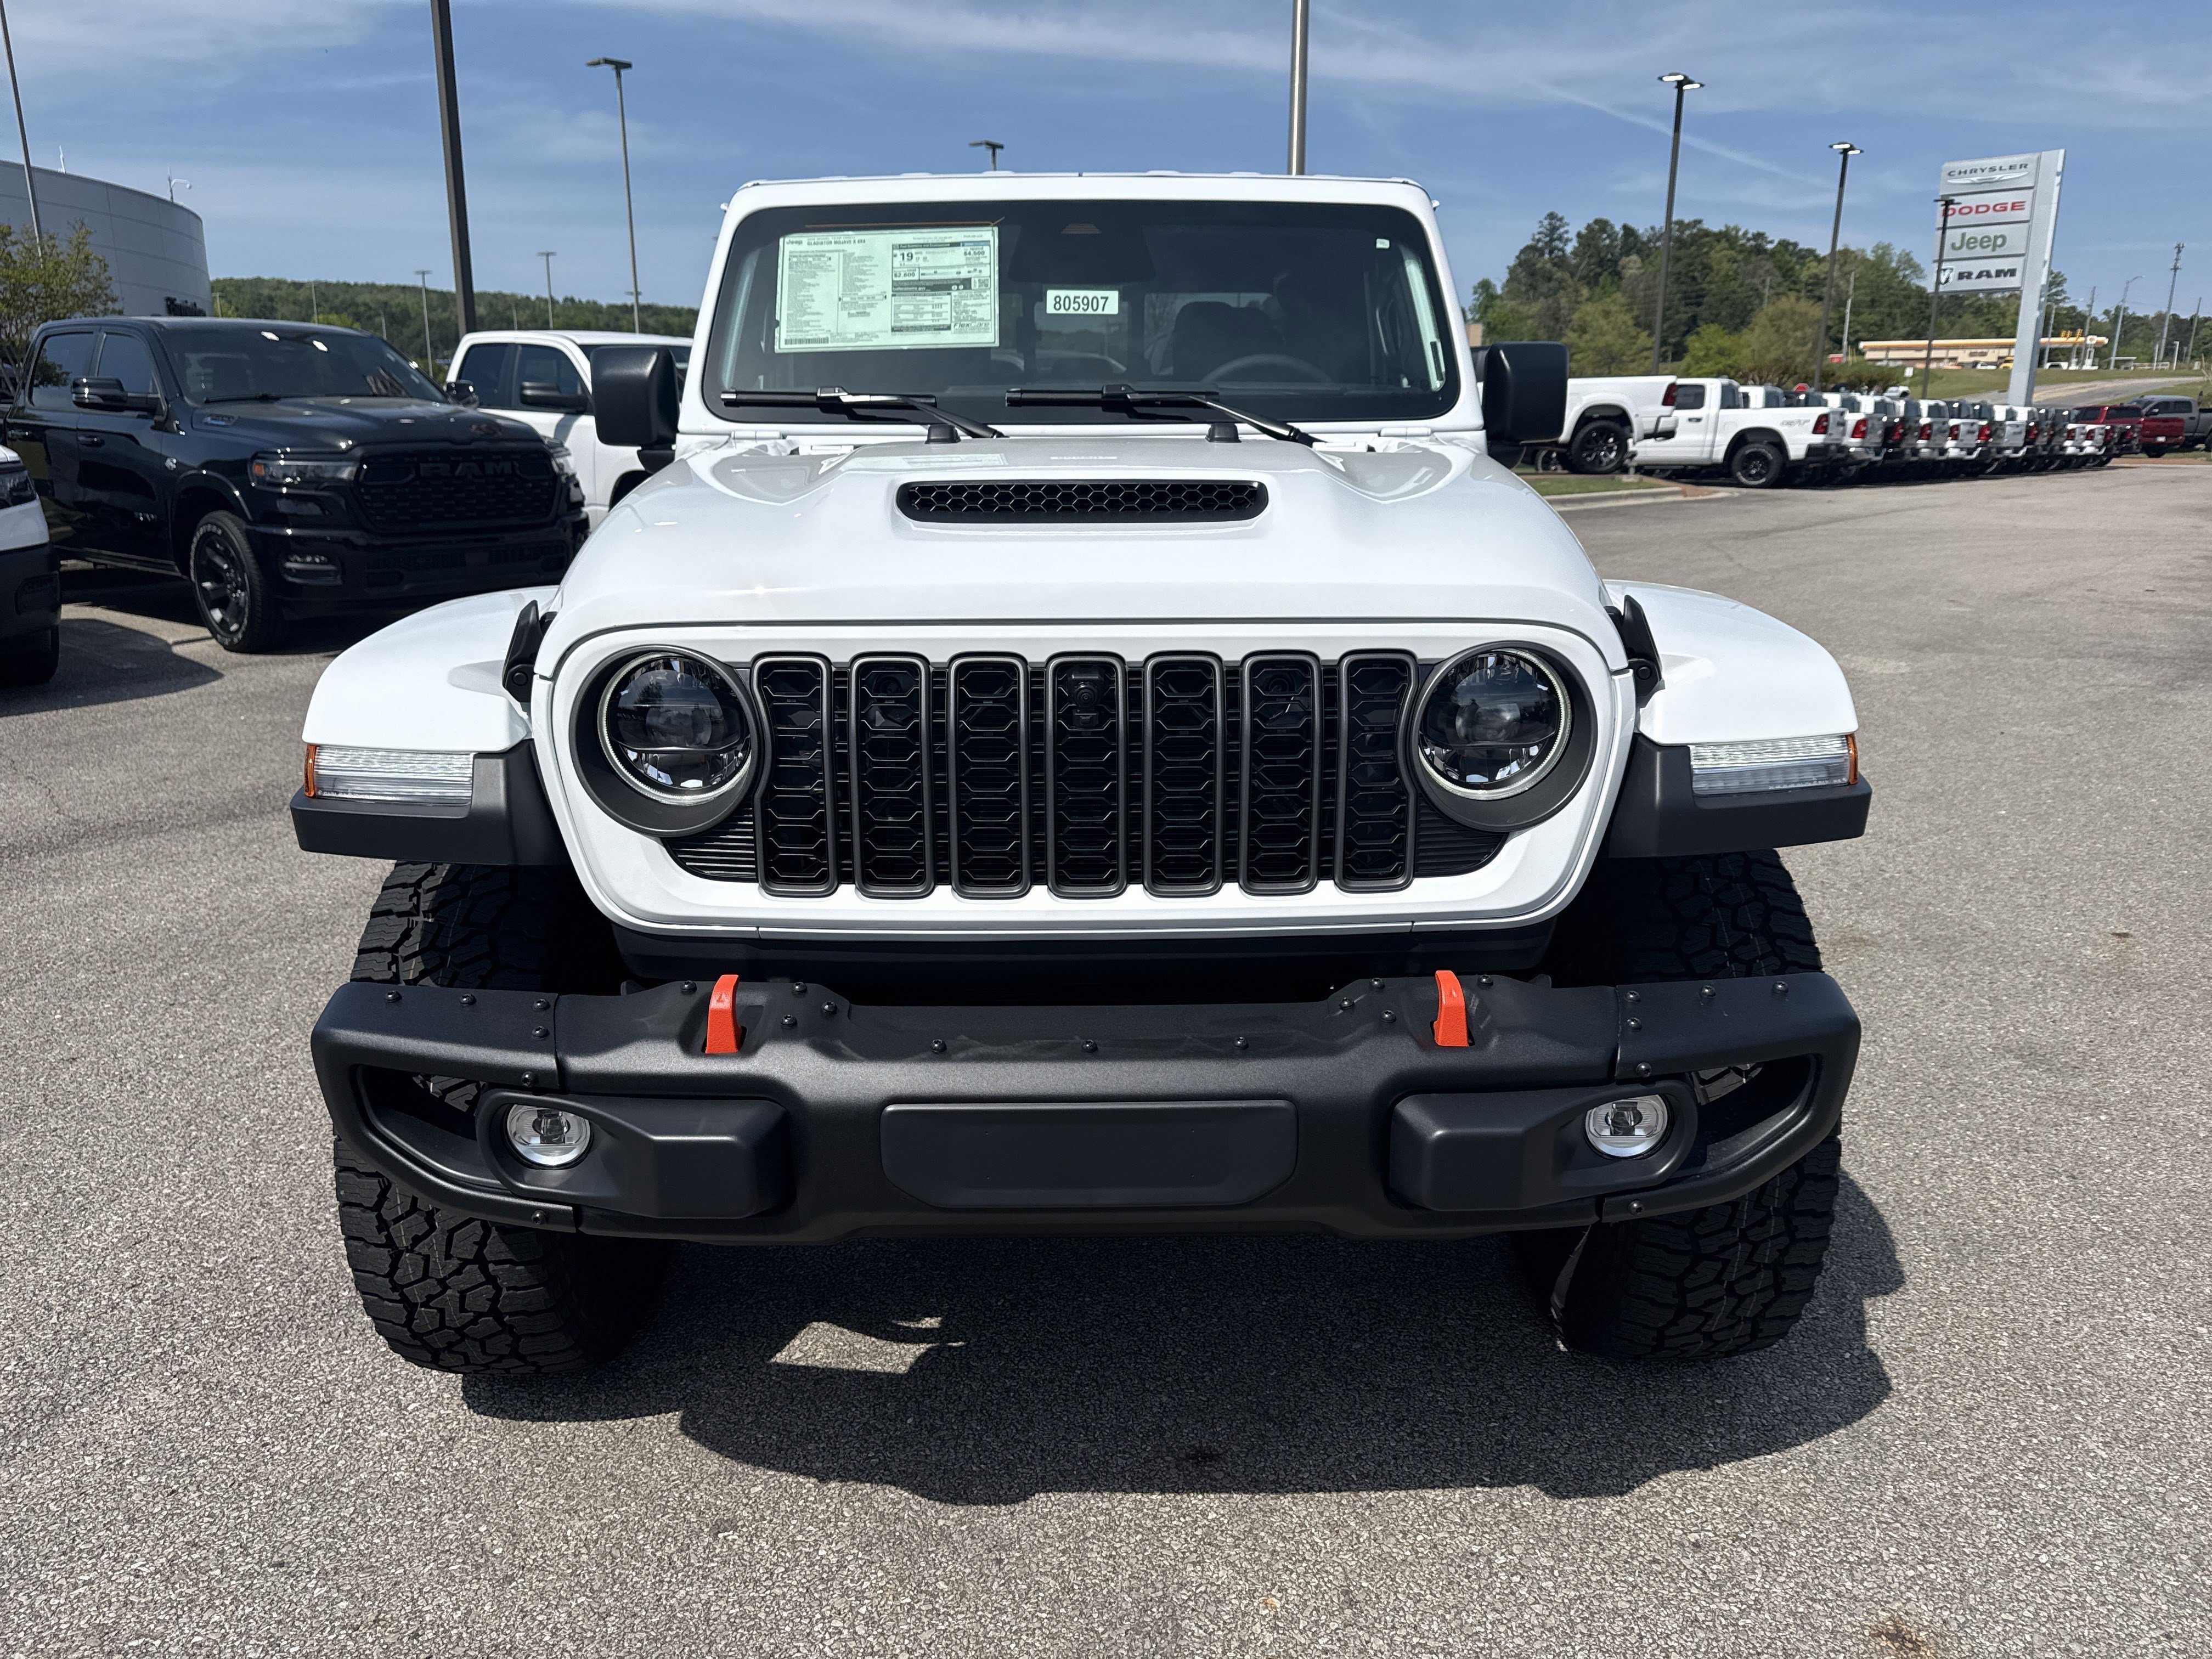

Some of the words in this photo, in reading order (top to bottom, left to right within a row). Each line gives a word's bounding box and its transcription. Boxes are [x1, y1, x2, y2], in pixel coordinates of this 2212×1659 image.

[1948, 163, 2028, 177] CHRYSLER
[1942, 200, 2026, 218] DODGE
[1951, 232, 2007, 252] Jeep
[900, 252, 913, 261] 19
[1957, 268, 2017, 280] RAM
[1053, 295, 1109, 312] 805907
